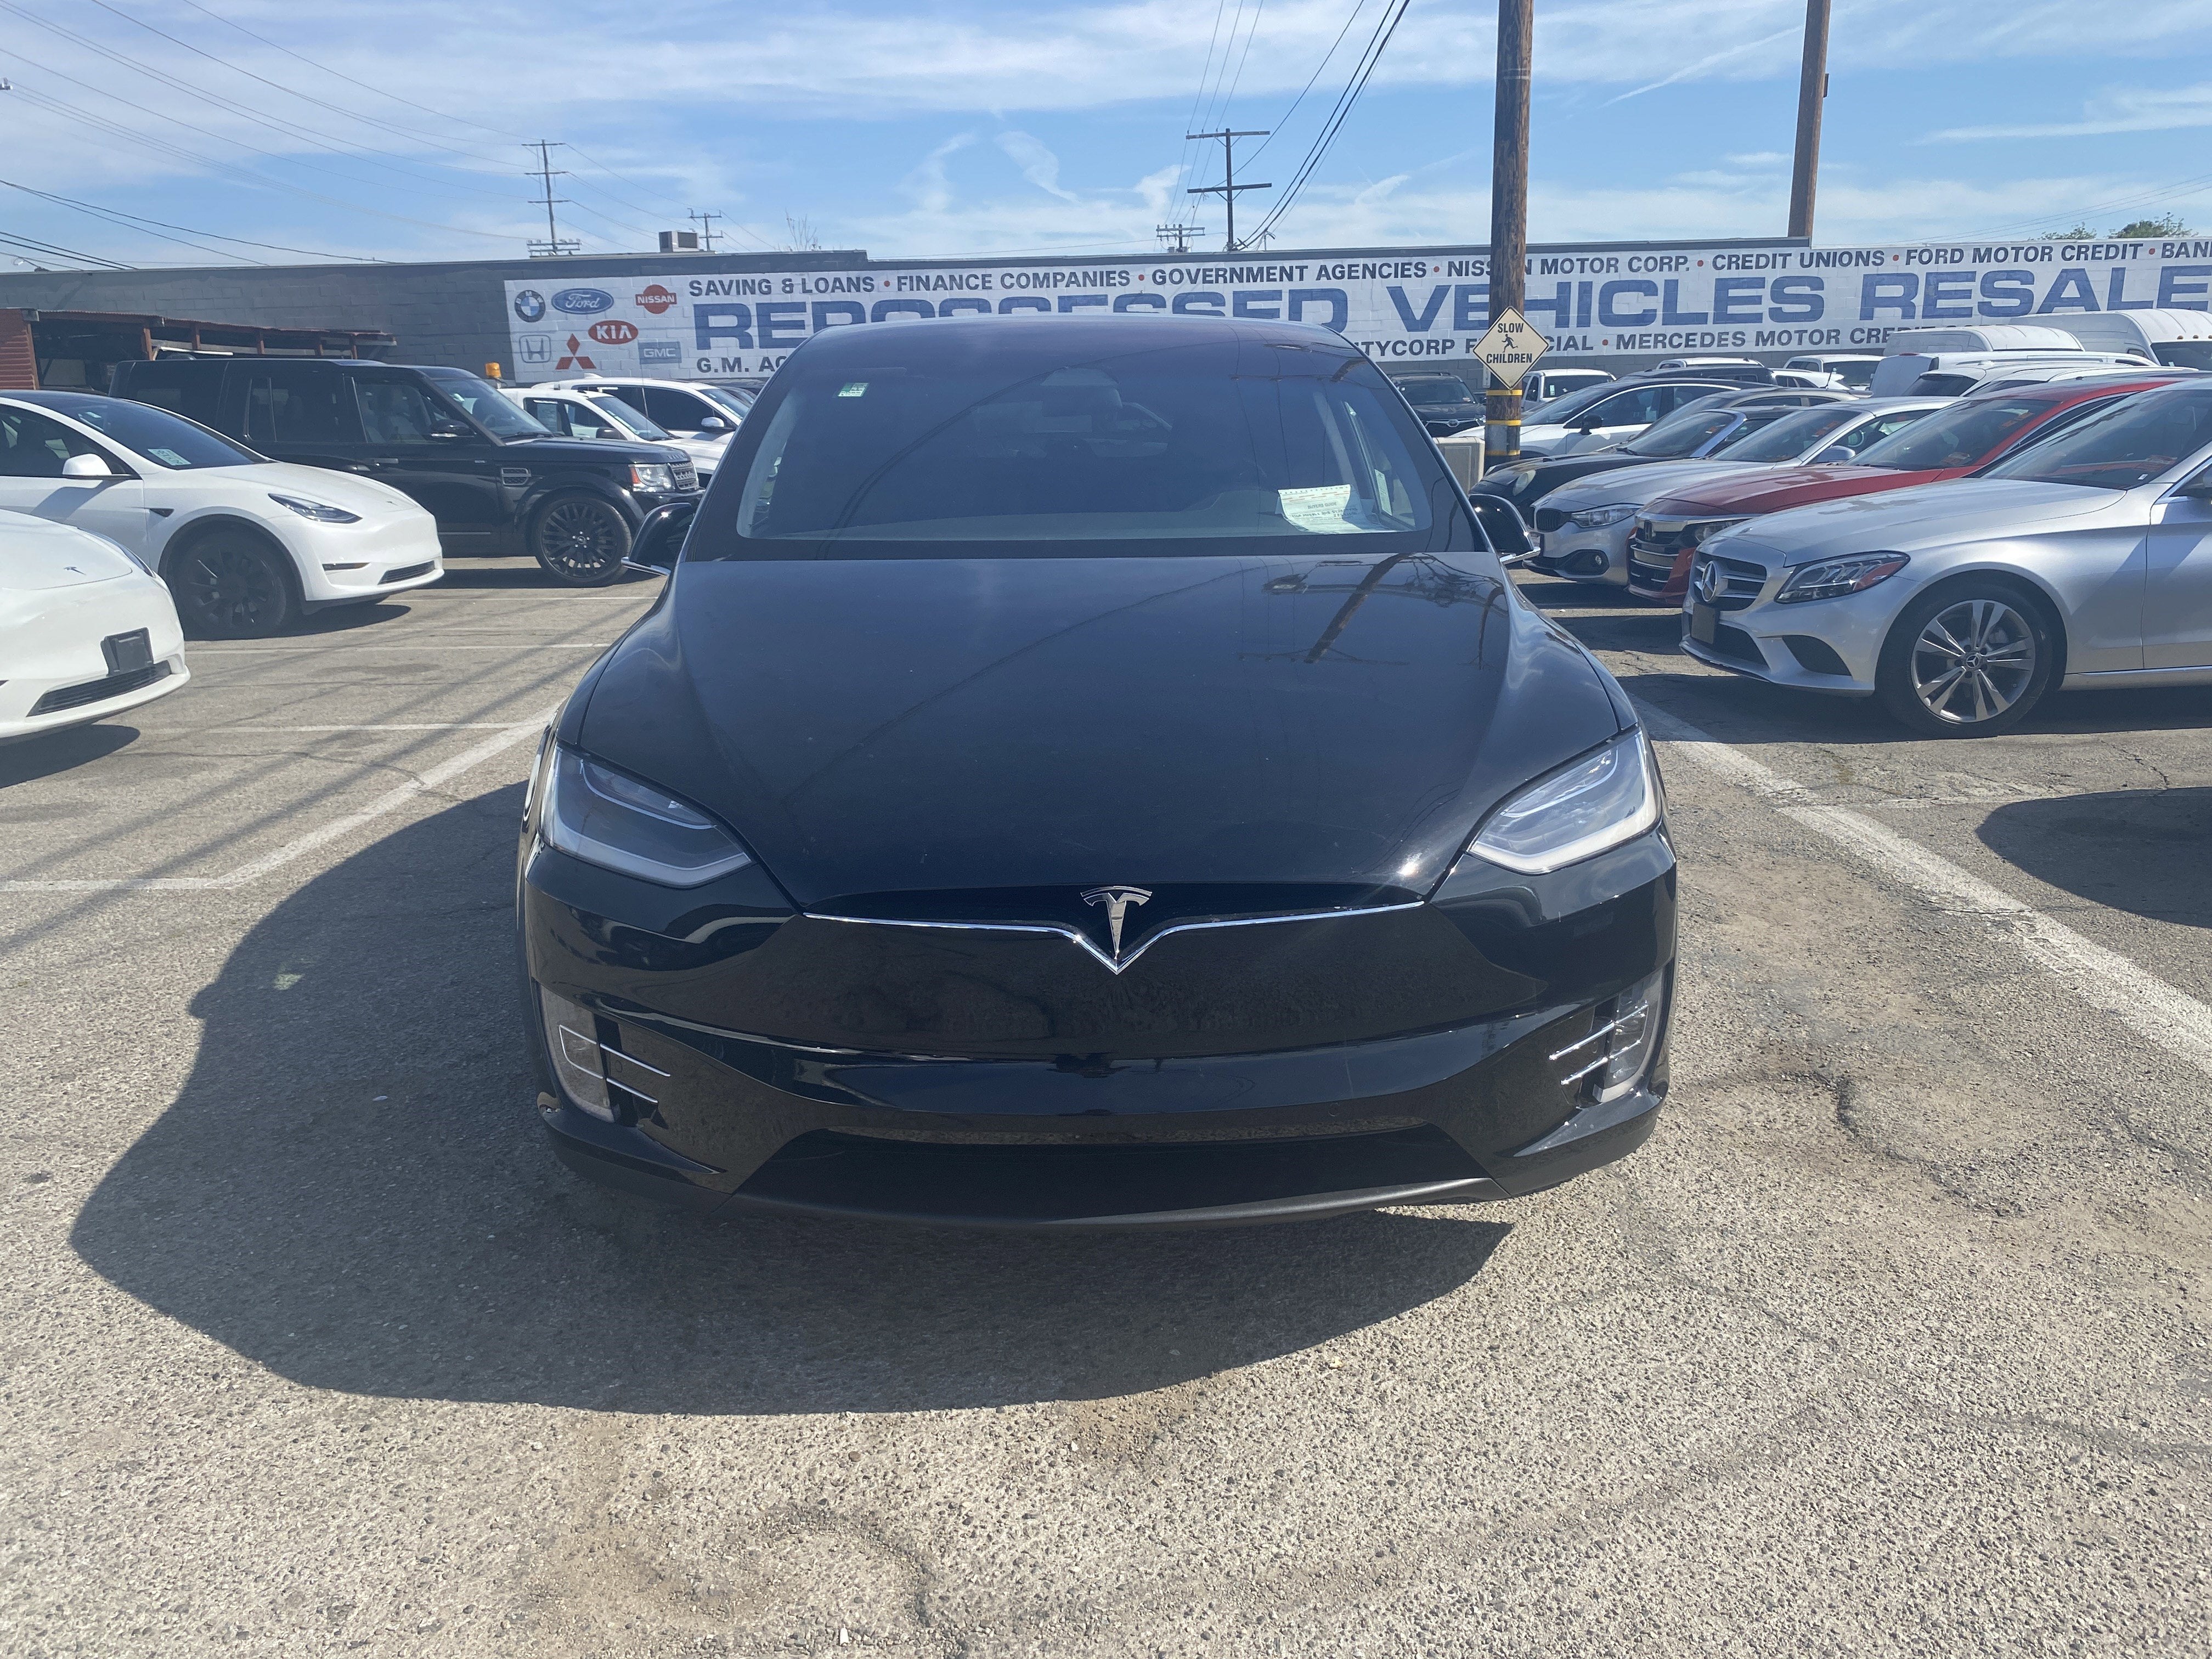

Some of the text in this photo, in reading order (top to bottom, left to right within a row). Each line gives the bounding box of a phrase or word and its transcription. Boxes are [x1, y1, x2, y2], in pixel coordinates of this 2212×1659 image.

[689, 241, 2212, 296] SAVING & LOANS FINANCE COMPANIES GOVERNMENT AGENCIES NISN MOTOR CORP. CREDIT UNIONS FORD MOTOR CREDIT BAN
[566, 293, 600, 308] Ford
[637, 295, 675, 303] NISSAN
[1386, 275, 1825, 332] VEHICLES
[1860, 265, 2212, 320] RESALE
[596, 325, 632, 340] KIA
[1497, 323, 1524, 333] SLOW
[643, 347, 676, 357] GMC
[697, 357, 749, 373] G.M.
[1616, 332, 1746, 349] MERCEDES
[1755, 329, 1840, 347] MOTOR
[1486, 353, 1533, 364] CHILDREN
